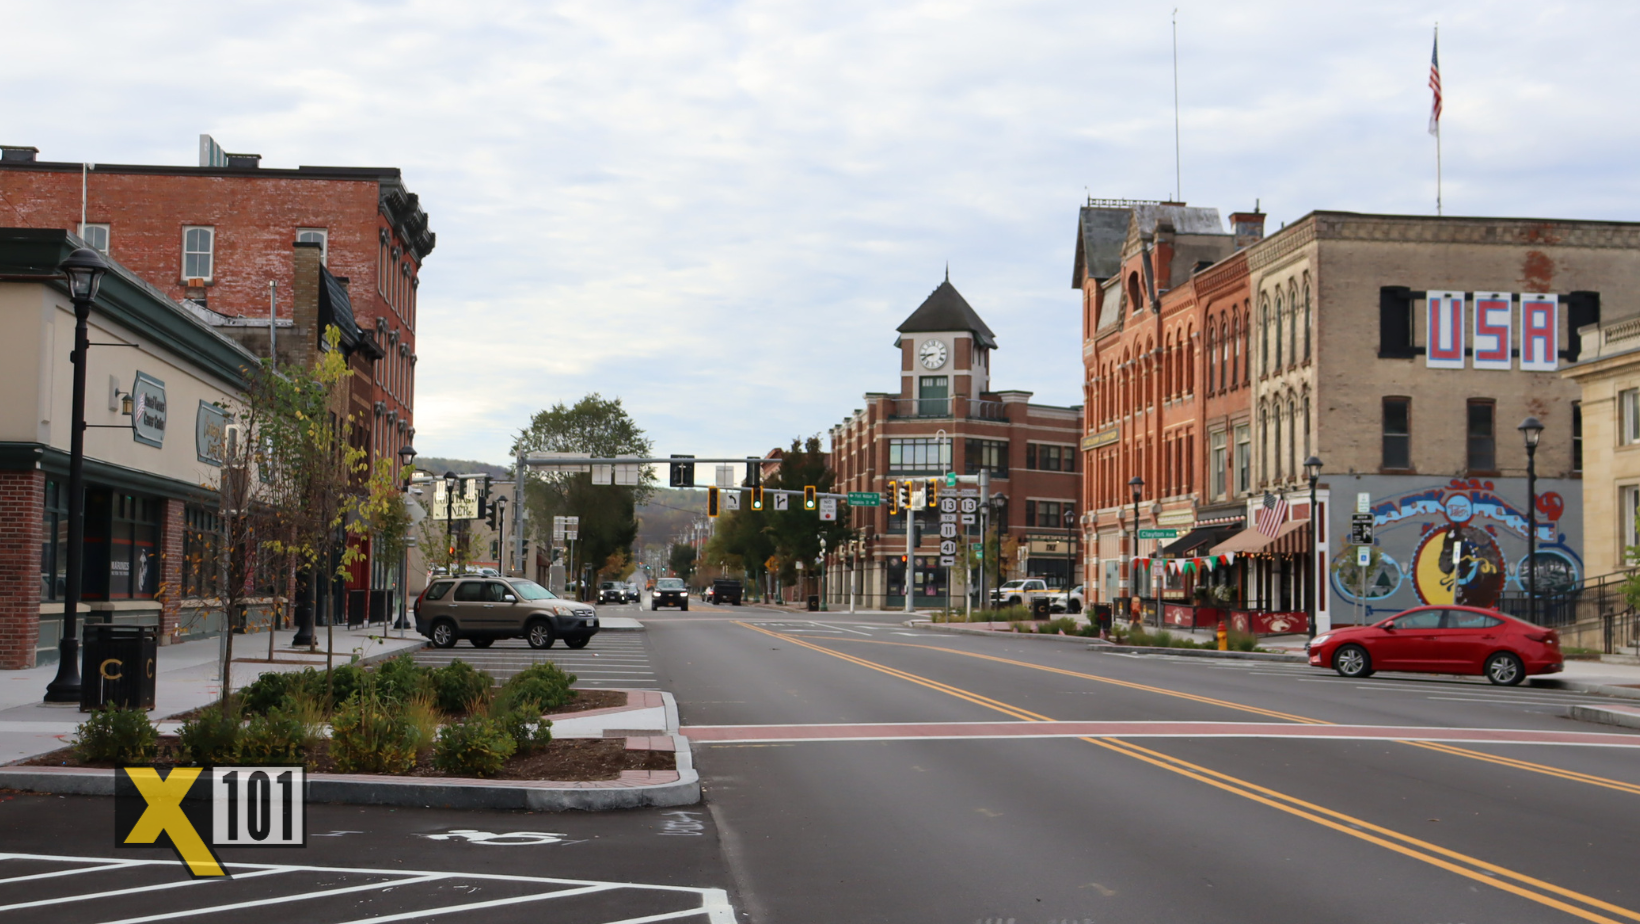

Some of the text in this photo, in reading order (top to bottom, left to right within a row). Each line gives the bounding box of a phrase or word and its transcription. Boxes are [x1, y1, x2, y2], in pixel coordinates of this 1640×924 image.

[1429, 298, 1555, 363] USA
[943, 500, 954, 510] 13
[963, 501, 974, 511] 13
[945, 526, 952, 535] 11
[943, 543, 954, 552] 41
[100, 658, 123, 680] C
[146, 658, 153, 679] C
